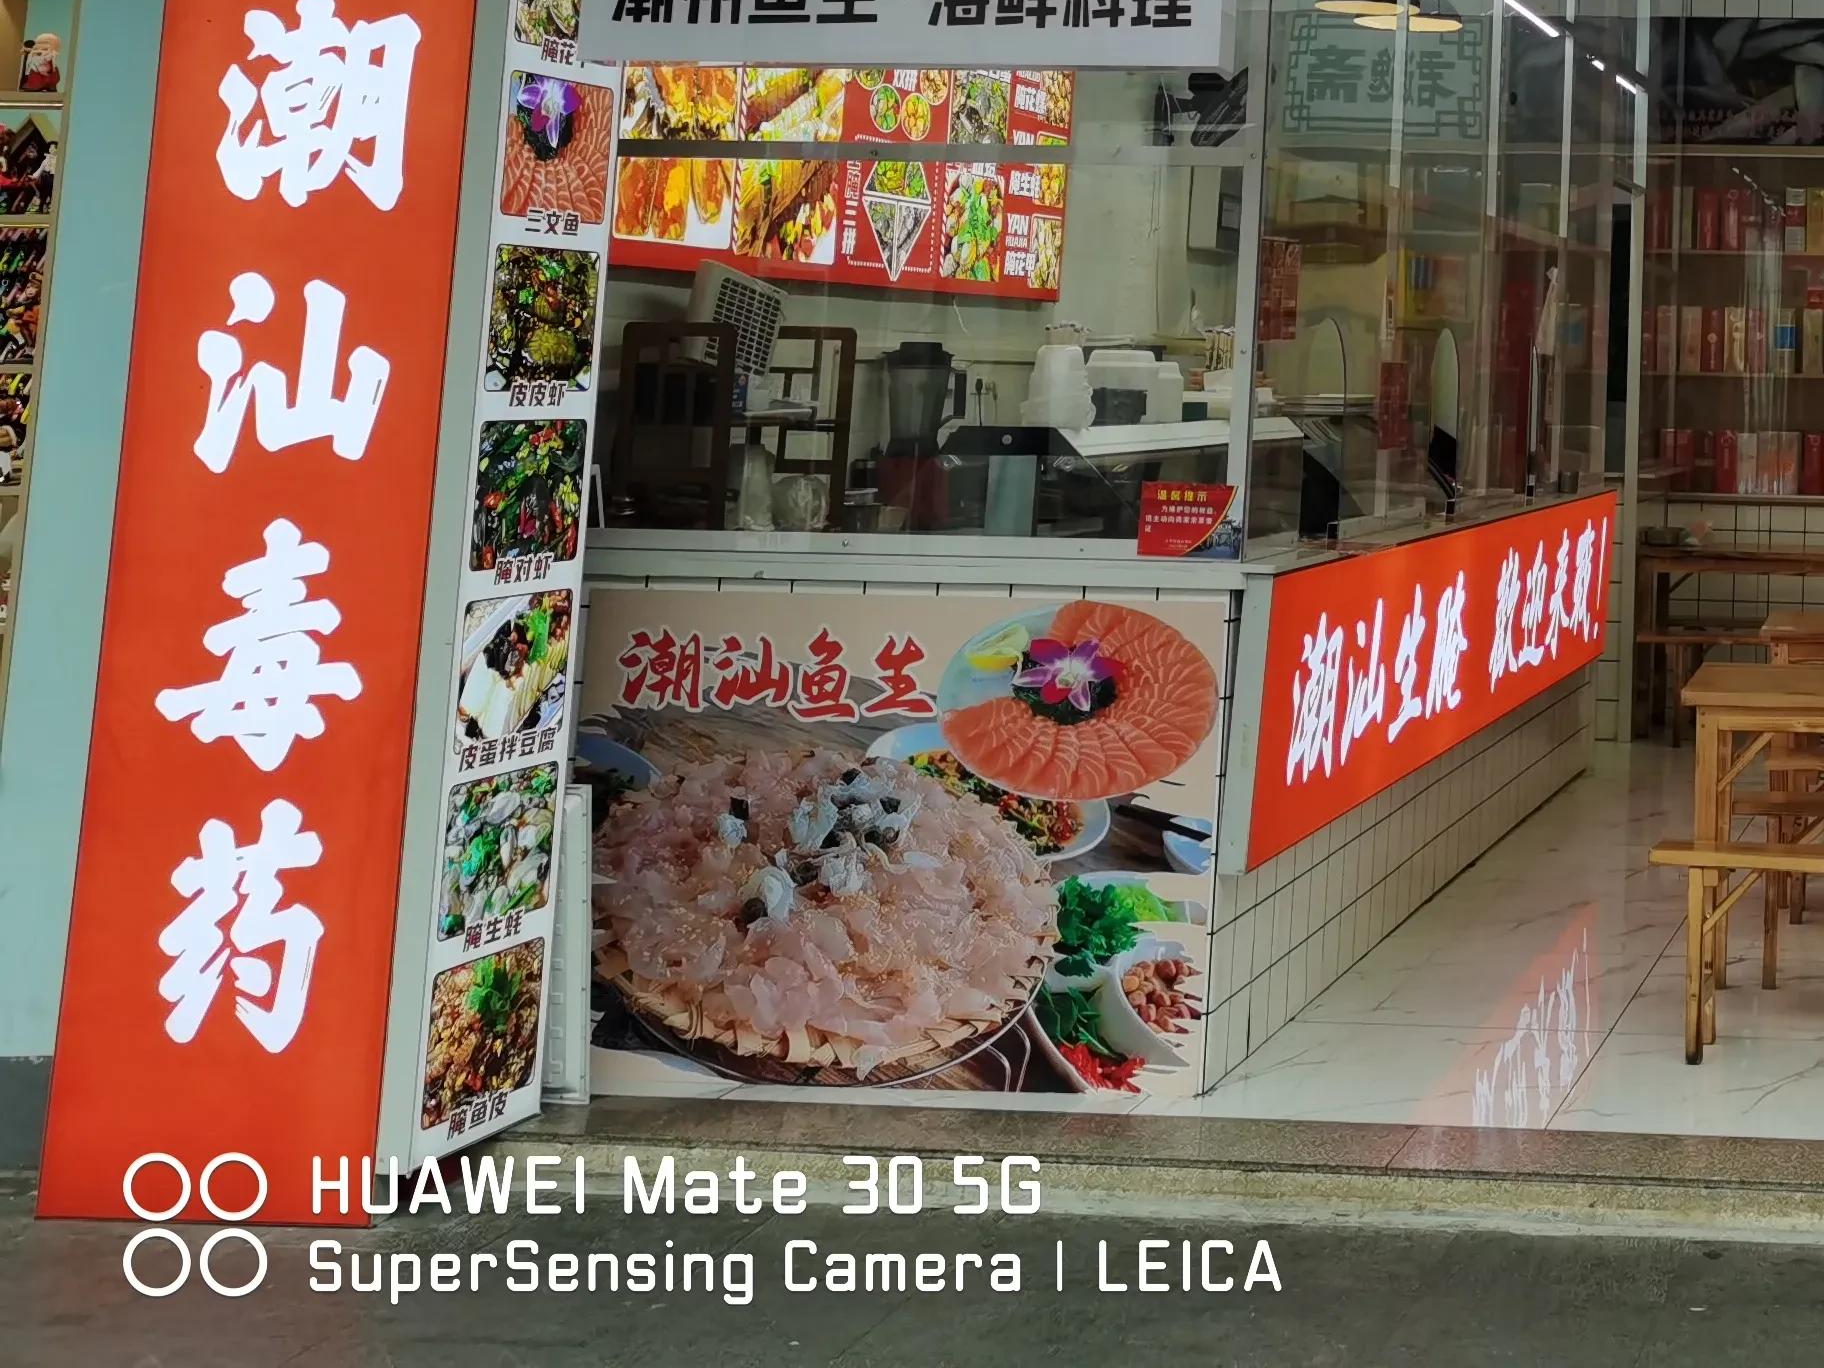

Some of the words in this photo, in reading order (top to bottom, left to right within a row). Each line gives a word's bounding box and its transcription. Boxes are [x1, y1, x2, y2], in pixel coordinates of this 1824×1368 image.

[541, 38, 585, 68] 腌花
[525, 209, 579, 236] 三文鱼
[509, 383, 567, 407] 皮皮虾
[494, 555, 552, 585] 腌对虾
[619, 628, 935, 719] 潮汕鱼生
[1287, 570, 1468, 786] 潮汕生腌
[458, 729, 556, 773] 皮蛋拌豆腐
[462, 912, 524, 952] 腌生蚝
[447, 1091, 509, 1141] 腌鱼皮
